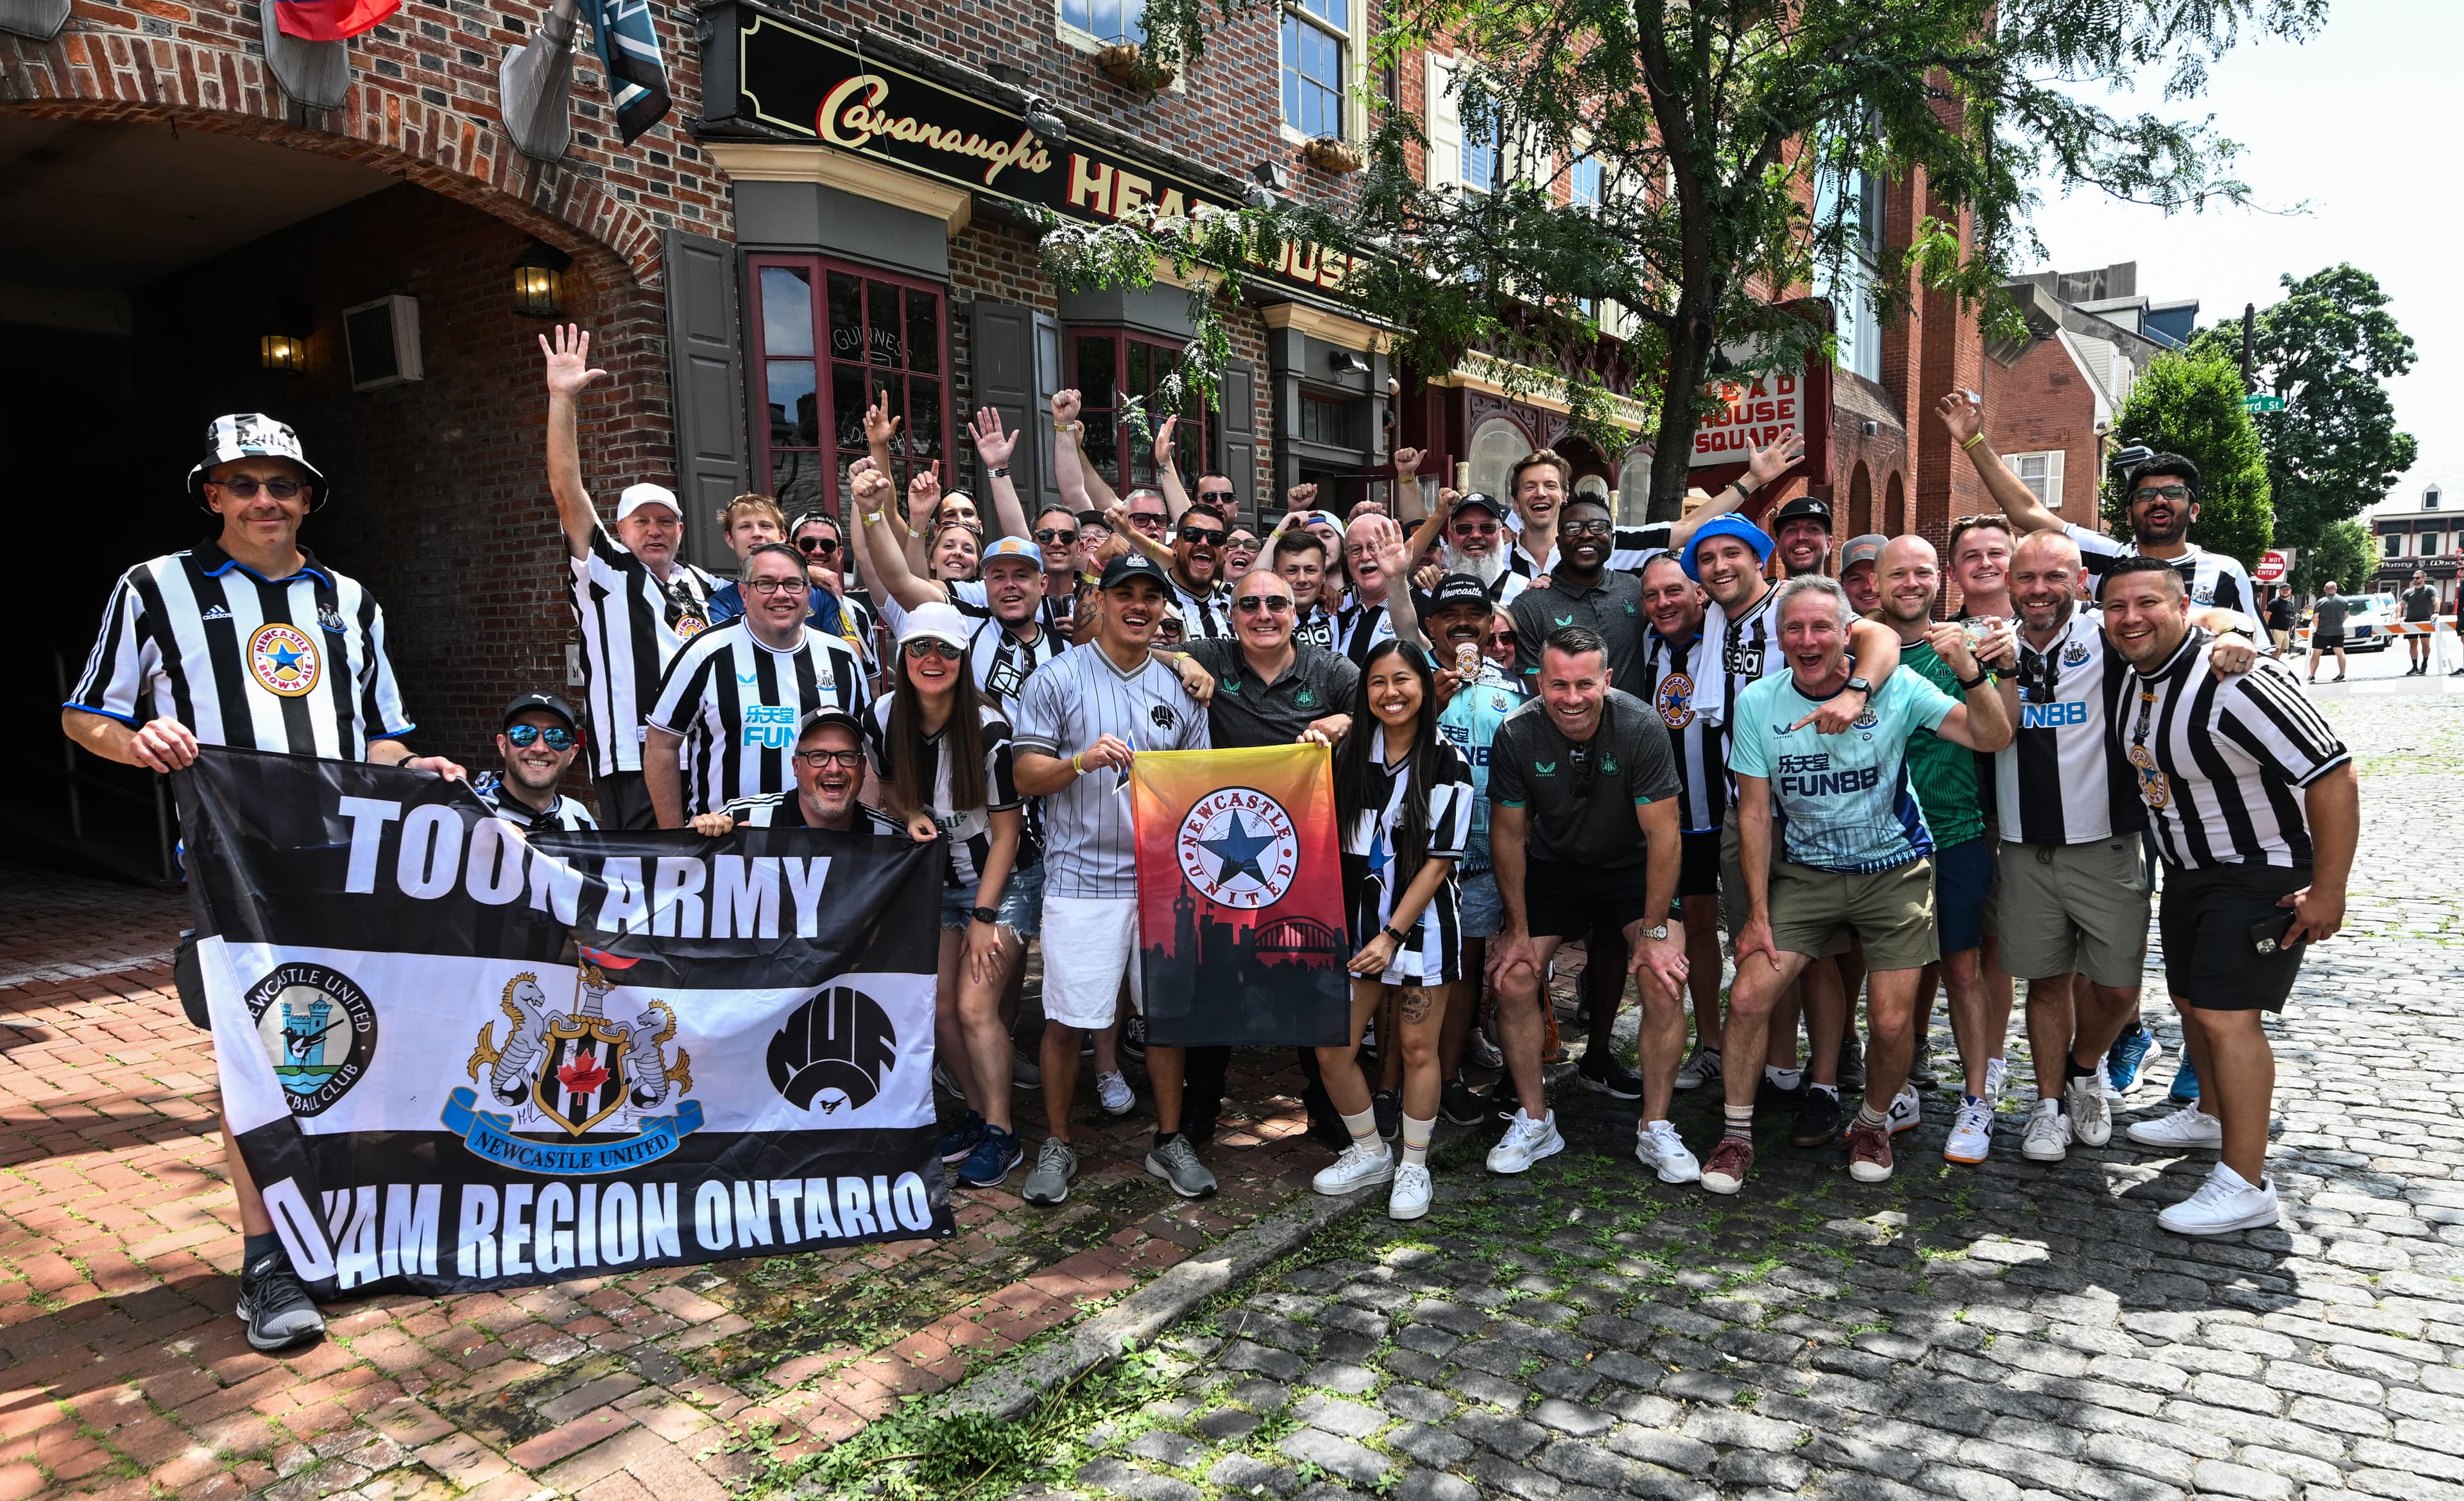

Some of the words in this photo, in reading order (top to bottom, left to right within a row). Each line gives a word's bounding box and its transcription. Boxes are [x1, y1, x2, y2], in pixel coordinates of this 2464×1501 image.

[814, 74, 1052, 186] Cavanaugh's
[2268, 401, 2280, 409] St
[1440, 587, 1483, 600] Newcastle
[202, 612, 233, 621] adidas
[678, 619, 704, 637] NEWCAST
[255, 630, 310, 653] NEWCASTLE
[259, 664, 301, 689] BROWN
[302, 663, 313, 682] ALE
[1661, 678, 1691, 698] NEWCASTLE
[744, 705, 795, 725] 乐天堂
[1660, 703, 1681, 725] BROWN
[1682, 706, 1691, 720] ALE
[1778, 752, 1830, 775] 乐天堂
[1780, 766, 1879, 797] FUN88
[1182, 793, 1292, 849] NEWCASTLE
[338, 795, 584, 927] TOON
[596, 854, 832, 939] ARMY
[1188, 863, 1292, 906] UNITED
[249, 968, 321, 1018] EWCASTLE
[325, 975, 371, 1033] UNITED
[284, 1093, 321, 1111] TBALL
[321, 1063, 359, 1101] CLUB
[474, 1131, 593, 1169] NEWCASTLE
[600, 1134, 669, 1167] UNITED
[458, 1181, 682, 1280] REGION
[694, 1171, 933, 1251] ONTARIO
